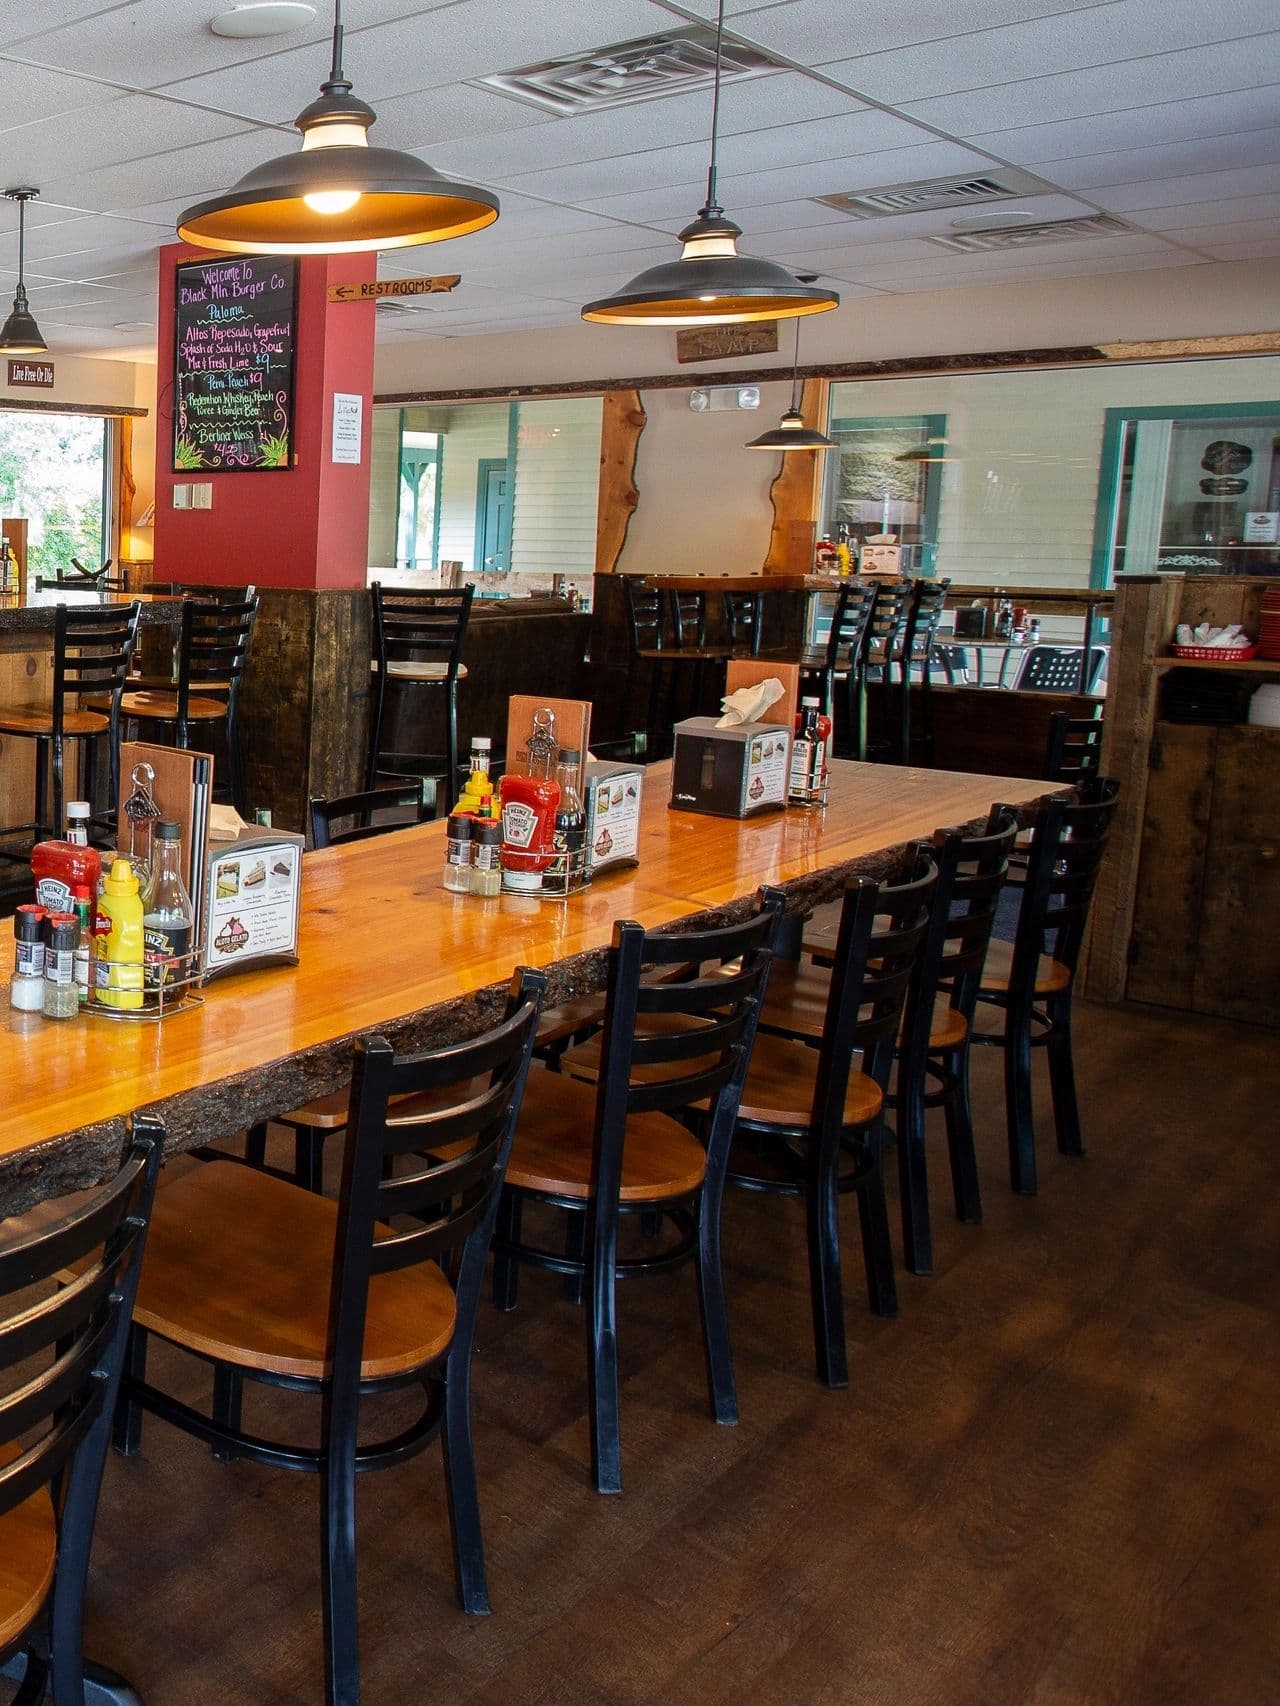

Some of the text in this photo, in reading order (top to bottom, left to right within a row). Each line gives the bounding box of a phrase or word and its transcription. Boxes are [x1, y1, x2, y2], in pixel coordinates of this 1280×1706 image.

[202, 261, 253, 285] Welcome To
[180, 287, 208, 305] Black
[231, 280, 266, 300] Burger
[361, 280, 432, 296] RESTROOMS
[206, 303, 245, 320] Paloma
[186, 325, 209, 341] Altos
[180, 342, 206, 359] Splash
[207, 346, 214, 356] of
[215, 342, 233, 356] Soda
[260, 339, 284, 353] Sour
[208, 354, 227, 370] Fresh
[229, 356, 250, 370] Lime
[255, 353, 270, 374] $9
[13, 365, 24, 381] Live
[24, 365, 36, 382] Free
[224, 371, 249, 388] Peach
[249, 372, 263, 391] $9
[251, 388, 274, 401] Peach
[222, 405, 243, 420] Ginger
[244, 404, 260, 417] Beer
[197, 427, 254, 443] Berliner Weiss
[510, 808, 527, 817] HEINZ
[509, 816, 528, 826] TOMATO
[44, 884, 63, 895] HEINZ
[43, 895, 65, 906] TOMATO
[144, 933, 163, 947] INZ
